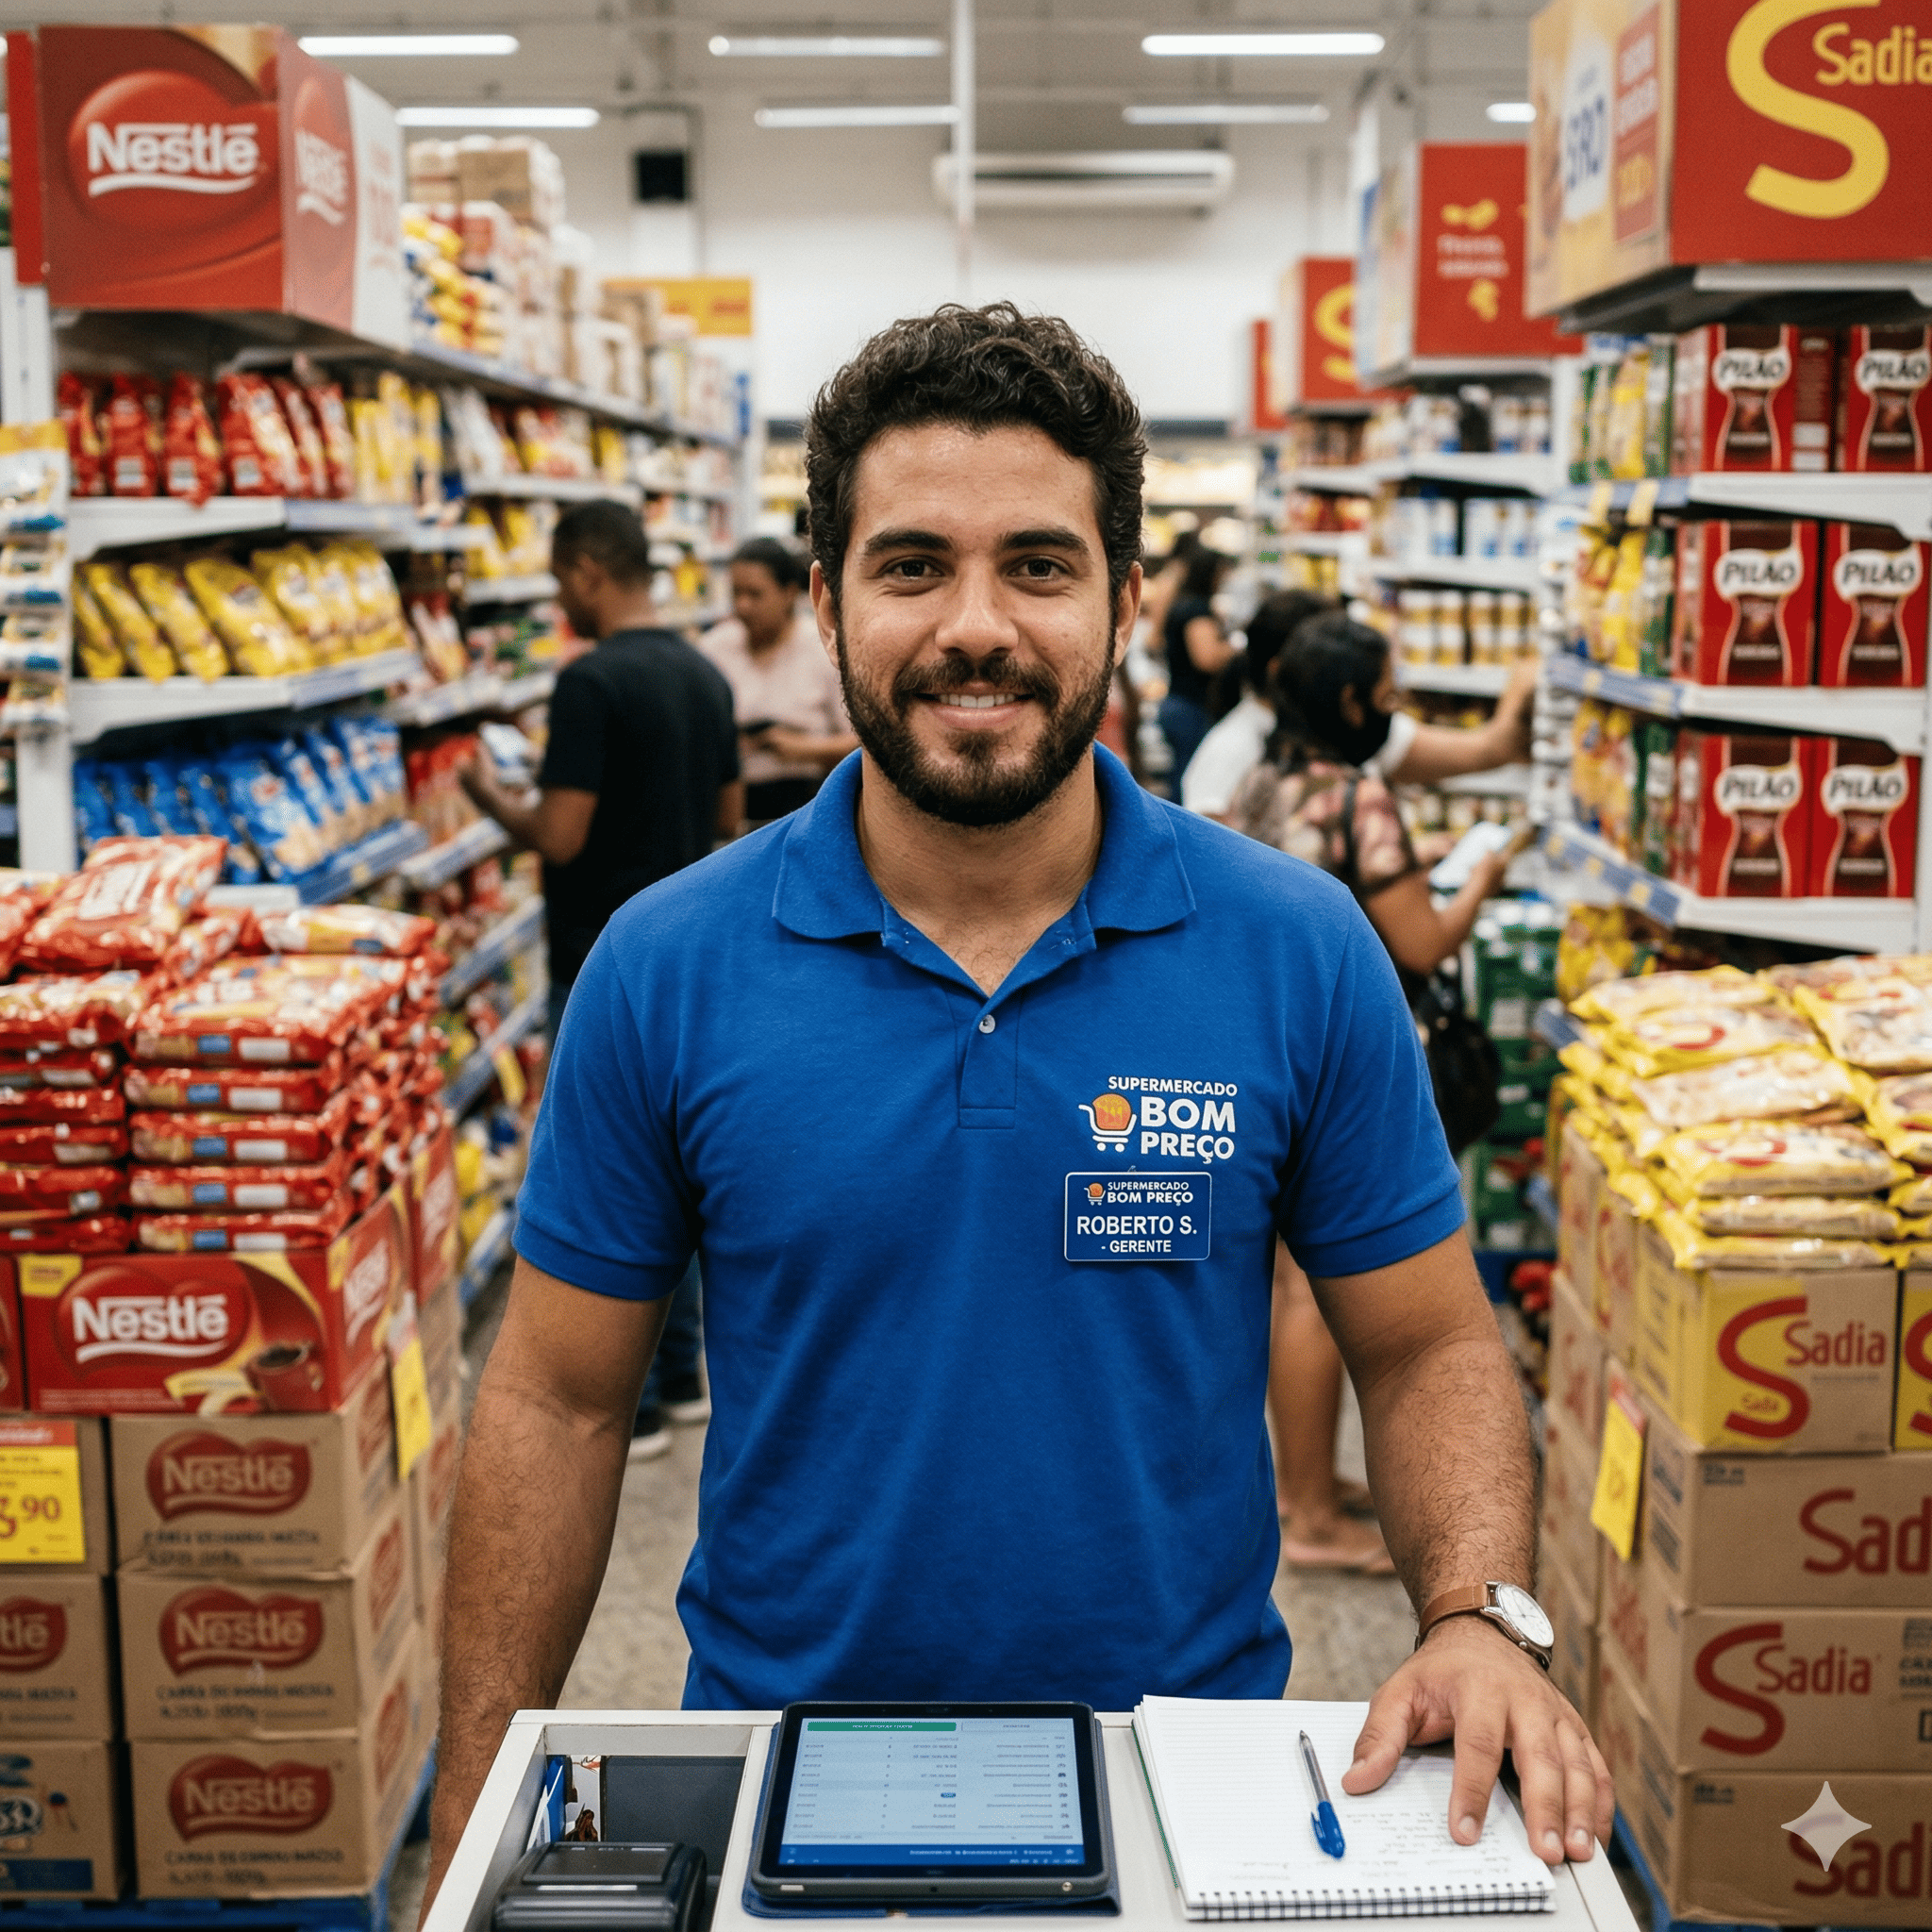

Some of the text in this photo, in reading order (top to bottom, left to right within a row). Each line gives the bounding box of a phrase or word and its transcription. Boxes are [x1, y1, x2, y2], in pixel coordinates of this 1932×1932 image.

[1812, 22, 1932, 86] Sadia
[1108, 1075, 1238, 1097] SUPERMERCADO
[1141, 1095, 1236, 1133] BOM
[1141, 1131, 1235, 1165] PREÇO
[1108, 1181, 1190, 1191] SUPERMERCADO
[1108, 1191, 1194, 1207] BOM PREÇO
[1076, 1215, 1198, 1235] ROBERTO S.
[1109, 1240, 1172, 1254] GERENTE
[1783, 1320, 1887, 1367] Sadia
[1799, 1487, 1932, 1575] Sad
[1753, 1643, 1872, 1695] Sadia
[1789, 1813, 1932, 1898] Sad
